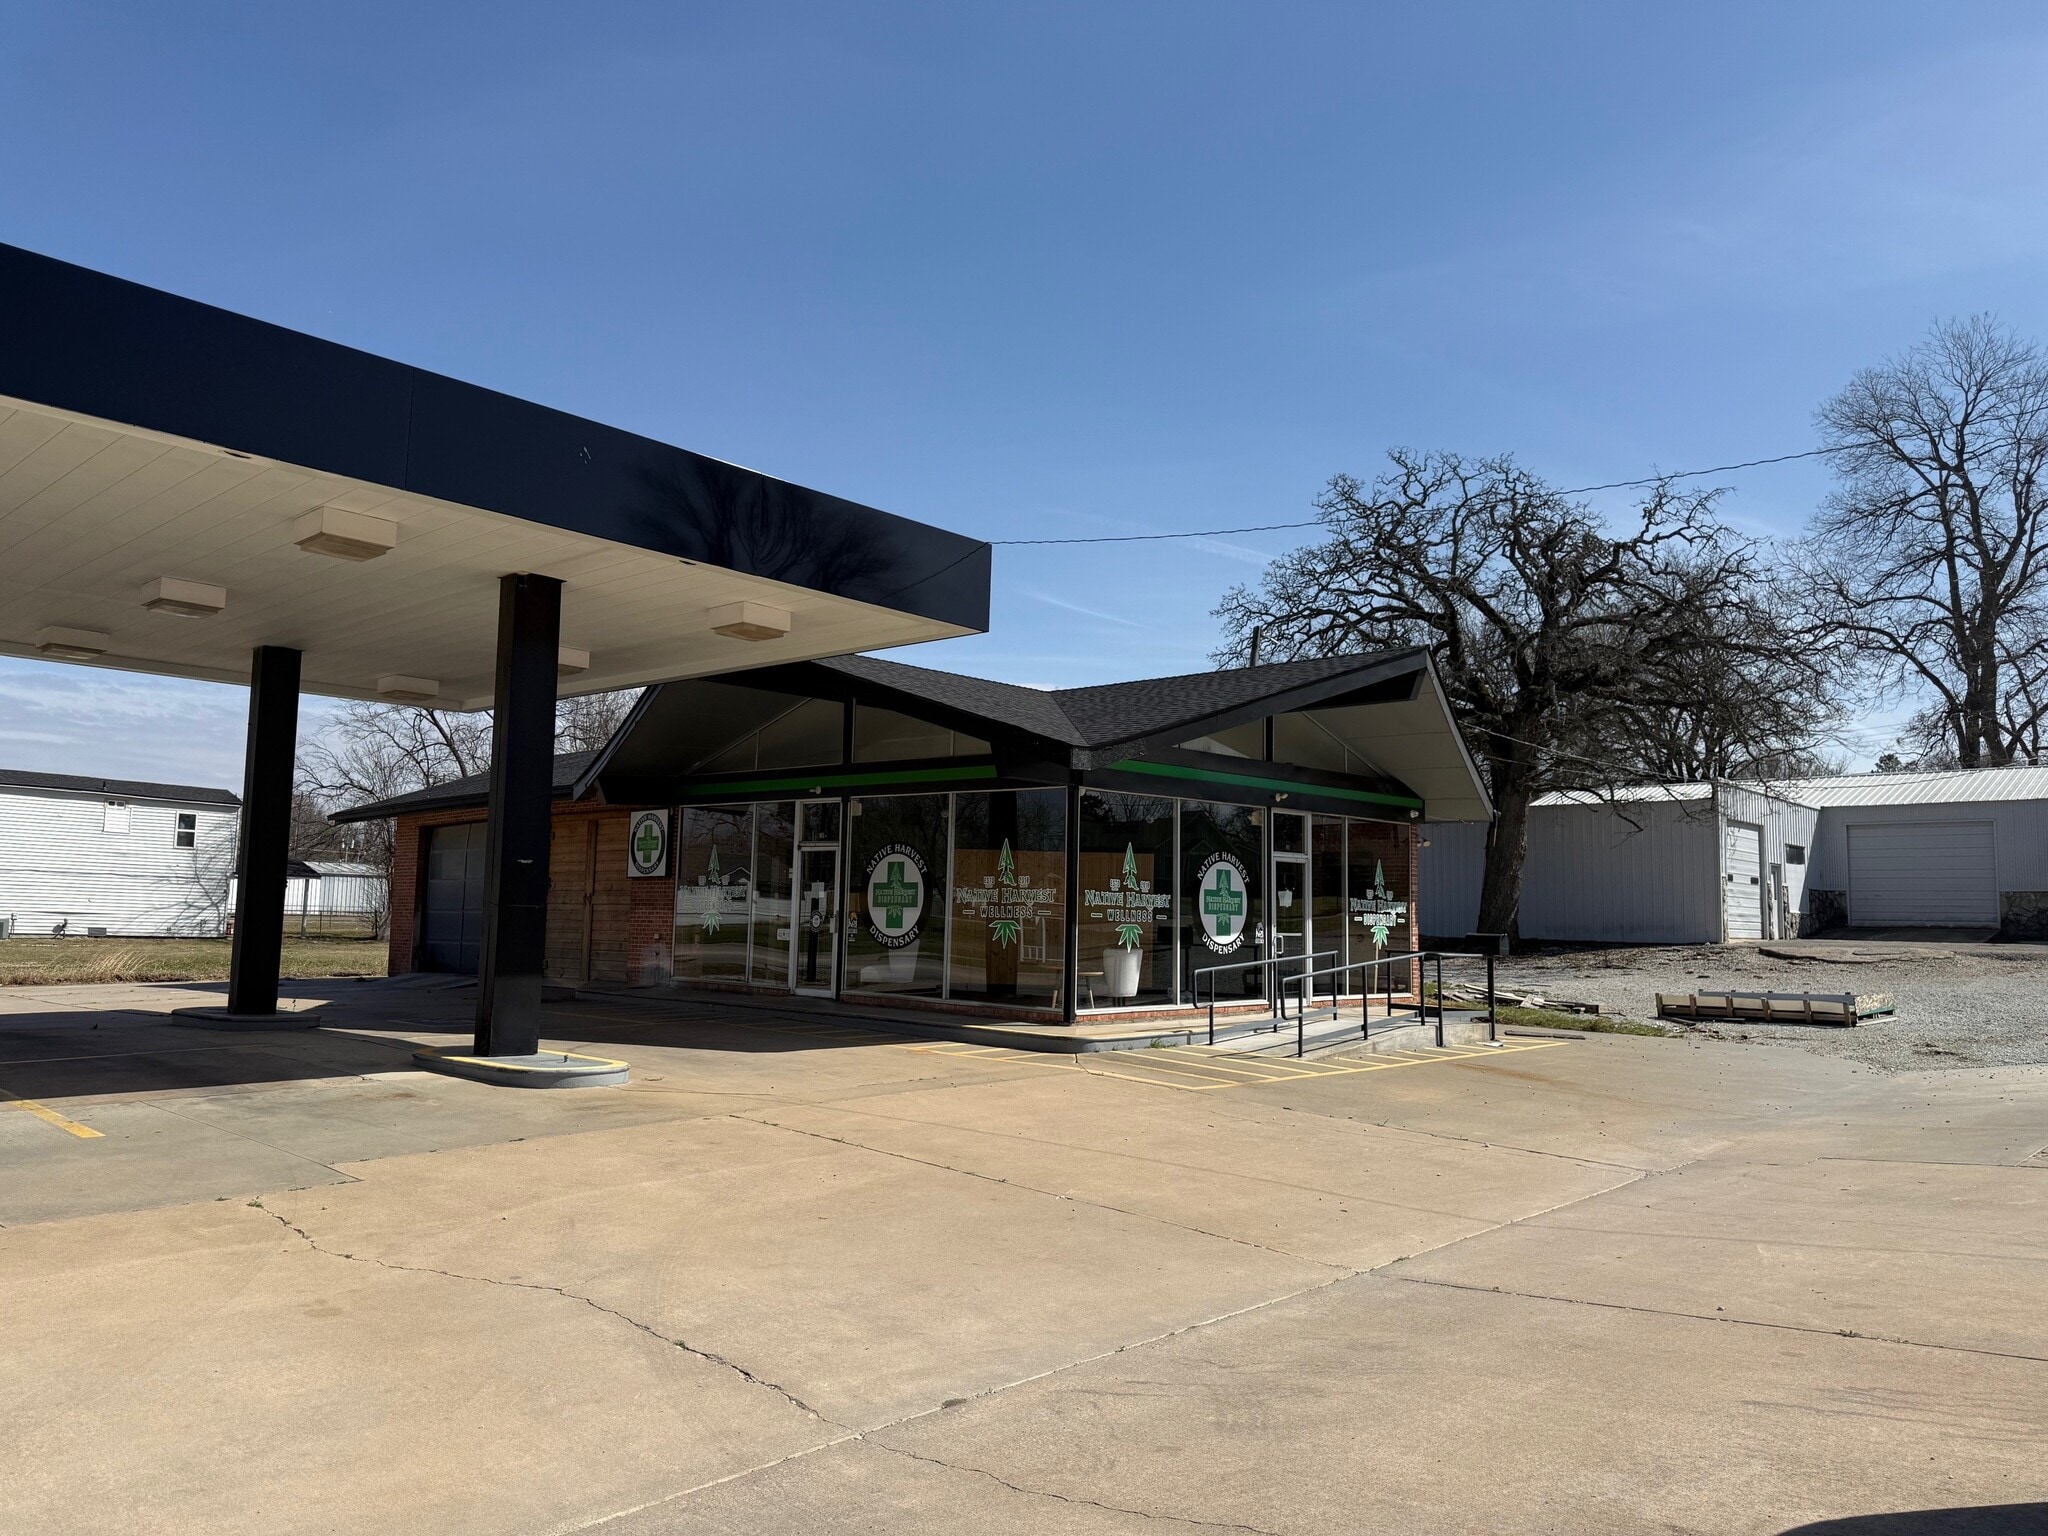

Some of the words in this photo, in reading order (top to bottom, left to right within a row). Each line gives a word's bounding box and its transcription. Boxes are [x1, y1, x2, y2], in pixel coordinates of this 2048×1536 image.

[866, 845, 892, 875] NATIVE
[894, 843, 928, 875] HARVEST
[1197, 852, 1221, 880] NATIVE
[1221, 851, 1250, 884] HARVEST
[956, 888, 998, 904] NATIVE
[1001, 887, 1057, 906] HARVEST
[1084, 889, 1124, 907] NATIVE
[1126, 891, 1171, 911] HARVEST
[979, 905, 1034, 918] WELLNESS
[1106, 908, 1153, 922] WELLNESS
[869, 926, 920, 947] DISPENSARY
[1201, 932, 1245, 955] DISPENSARY
